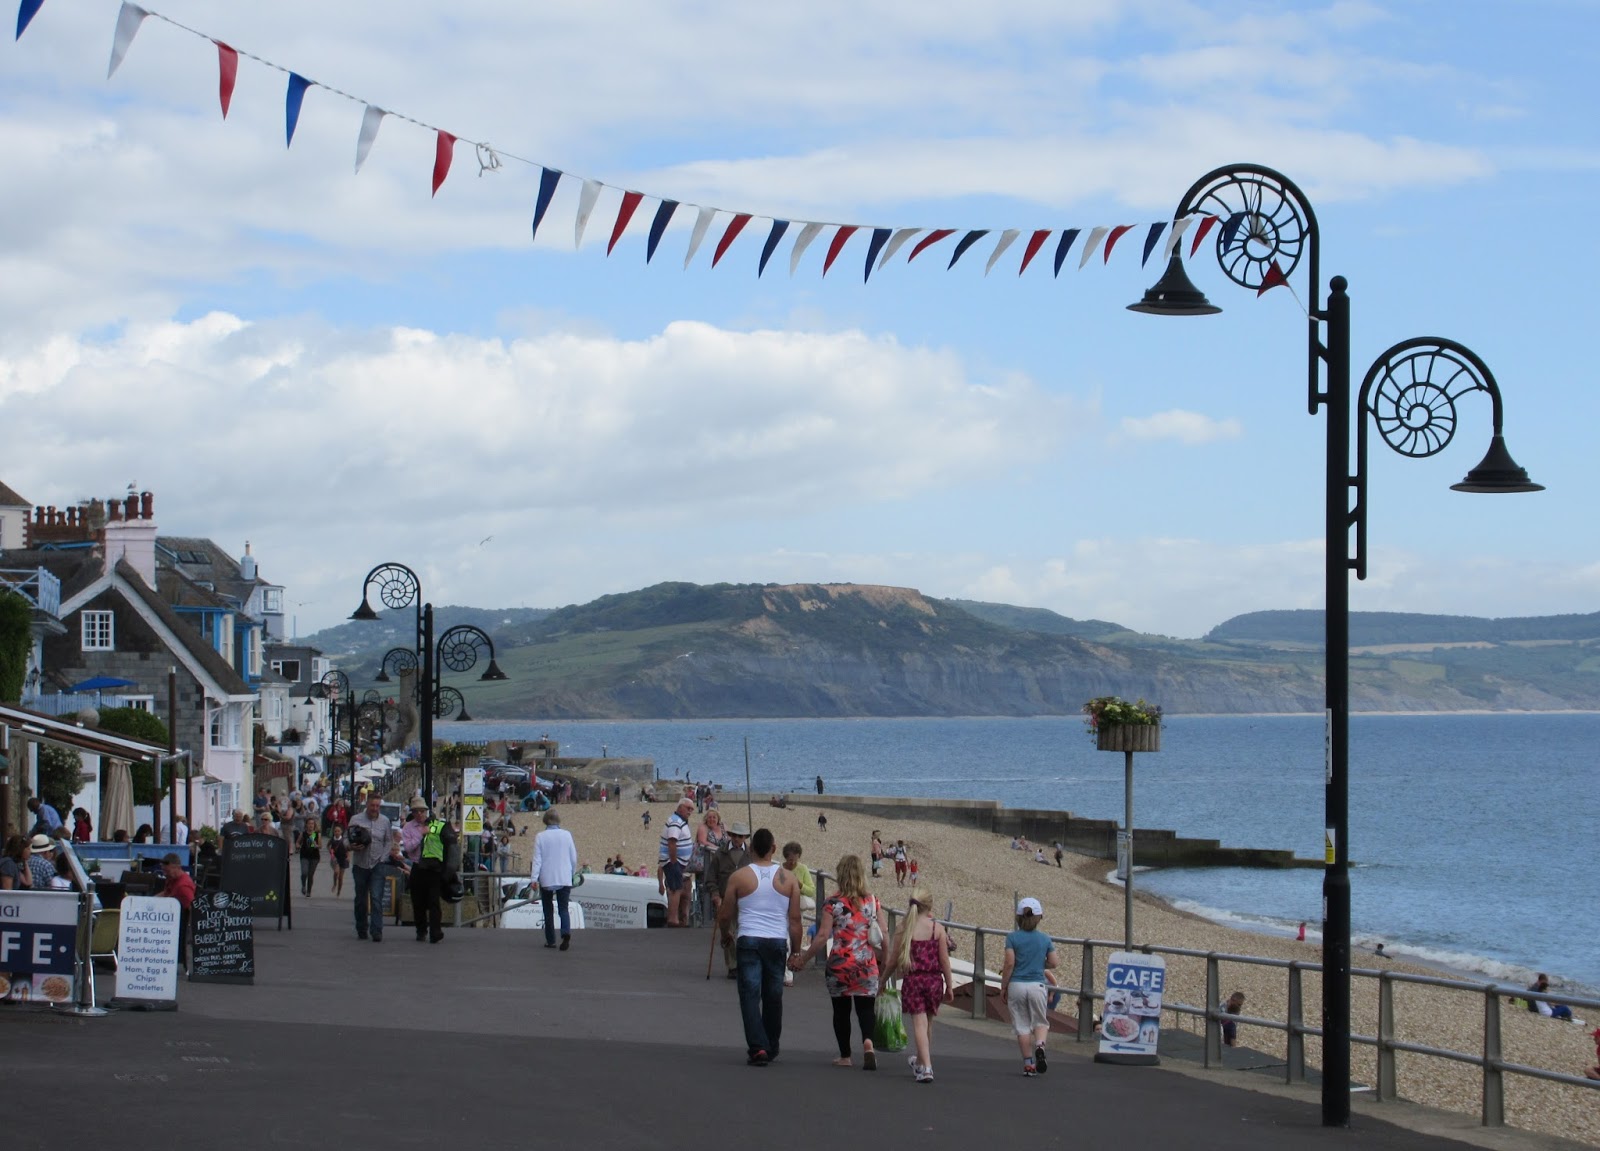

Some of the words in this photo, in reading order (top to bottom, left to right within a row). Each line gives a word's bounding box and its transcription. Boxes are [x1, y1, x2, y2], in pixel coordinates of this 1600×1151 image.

[193, 894, 208, 909] EAT
[231, 892, 250, 905] TAKE
[228, 901, 250, 911] AWAY
[611, 903, 628, 912] Drinks
[628, 905, 638, 913] Ltd
[126, 911, 174, 922] LARGIGI
[206, 909, 229, 920] LOCAL
[197, 918, 221, 930] FRESH
[223, 916, 253, 927] HADDOCK
[126, 926, 141, 934] Fish
[150, 927, 171, 936] Chips
[143, 937, 171, 946] Burgers
[194, 932, 222, 945] BUBBLY
[224, 930, 252, 942] BATTER
[126, 946, 169, 955] Sandwiches
[144, 957, 175, 965] Potatoes
[146, 966, 160, 975] Egg
[135, 974, 157, 982] Chips
[1109, 967, 1162, 989] CAFE
[127, 983, 164, 992] Omelettes
